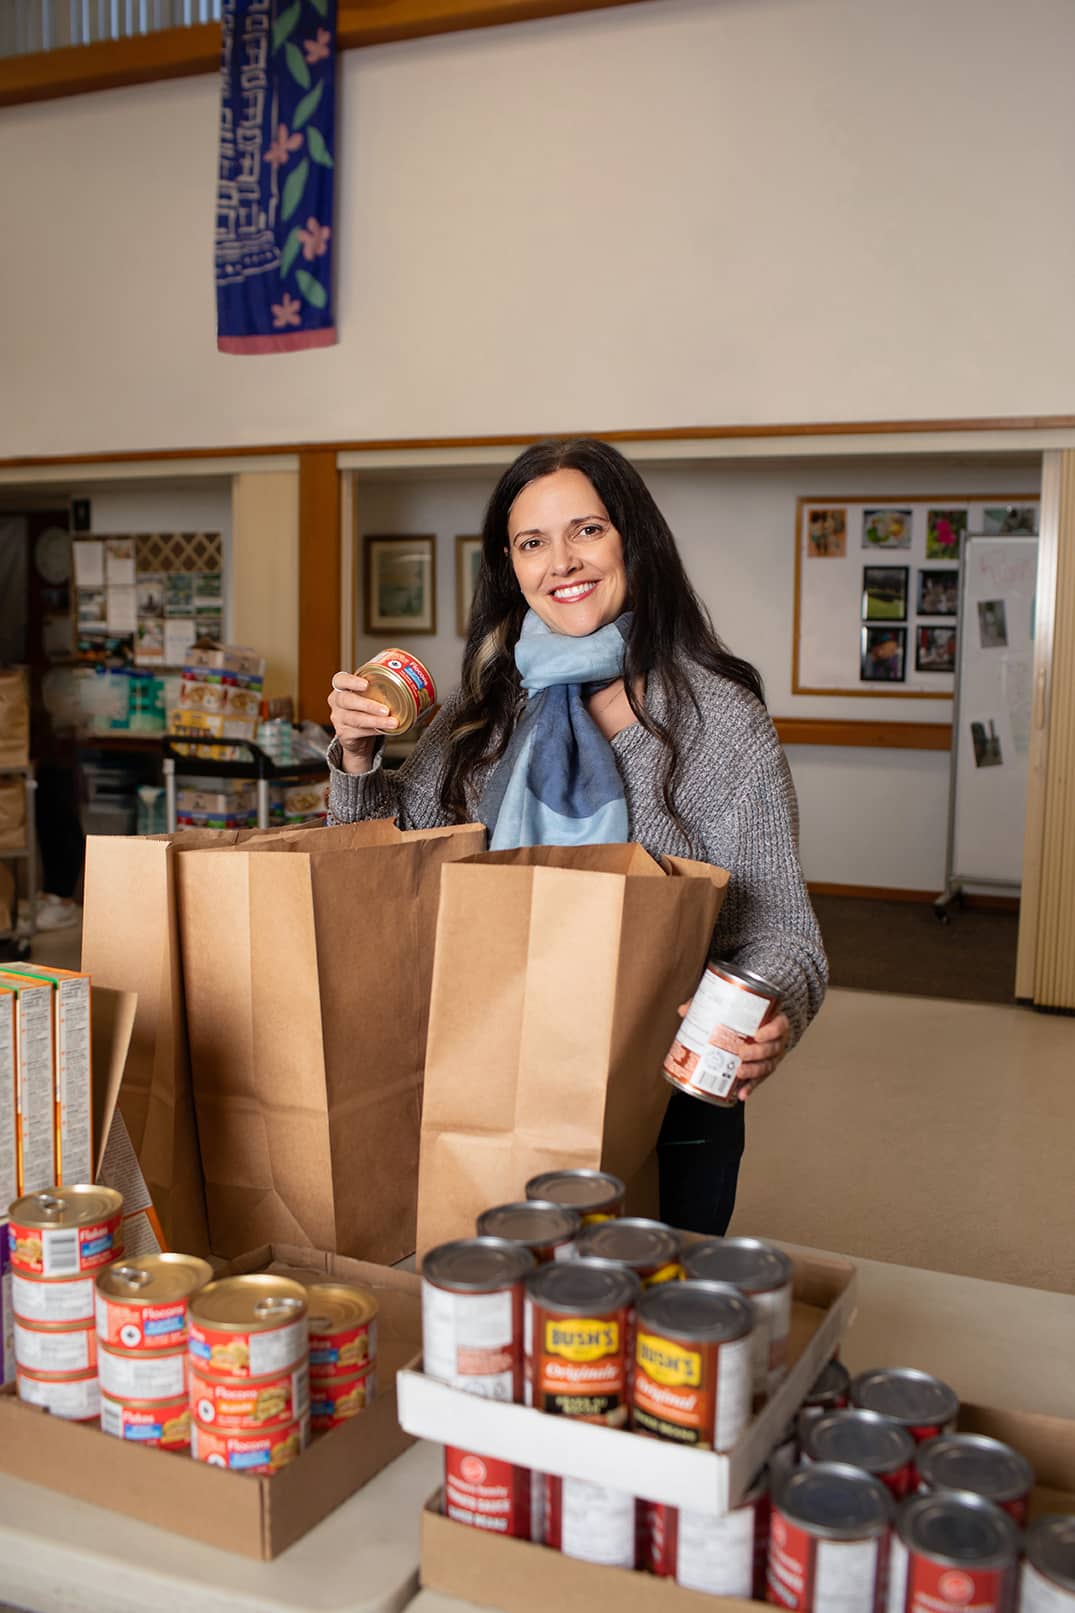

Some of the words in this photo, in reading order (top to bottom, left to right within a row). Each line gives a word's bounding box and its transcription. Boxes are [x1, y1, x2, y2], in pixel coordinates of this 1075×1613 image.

[552, 1327, 614, 1346] BUSH'S
[641, 1344, 694, 1377] BUSH'S
[636, 1375, 696, 1410] Original
